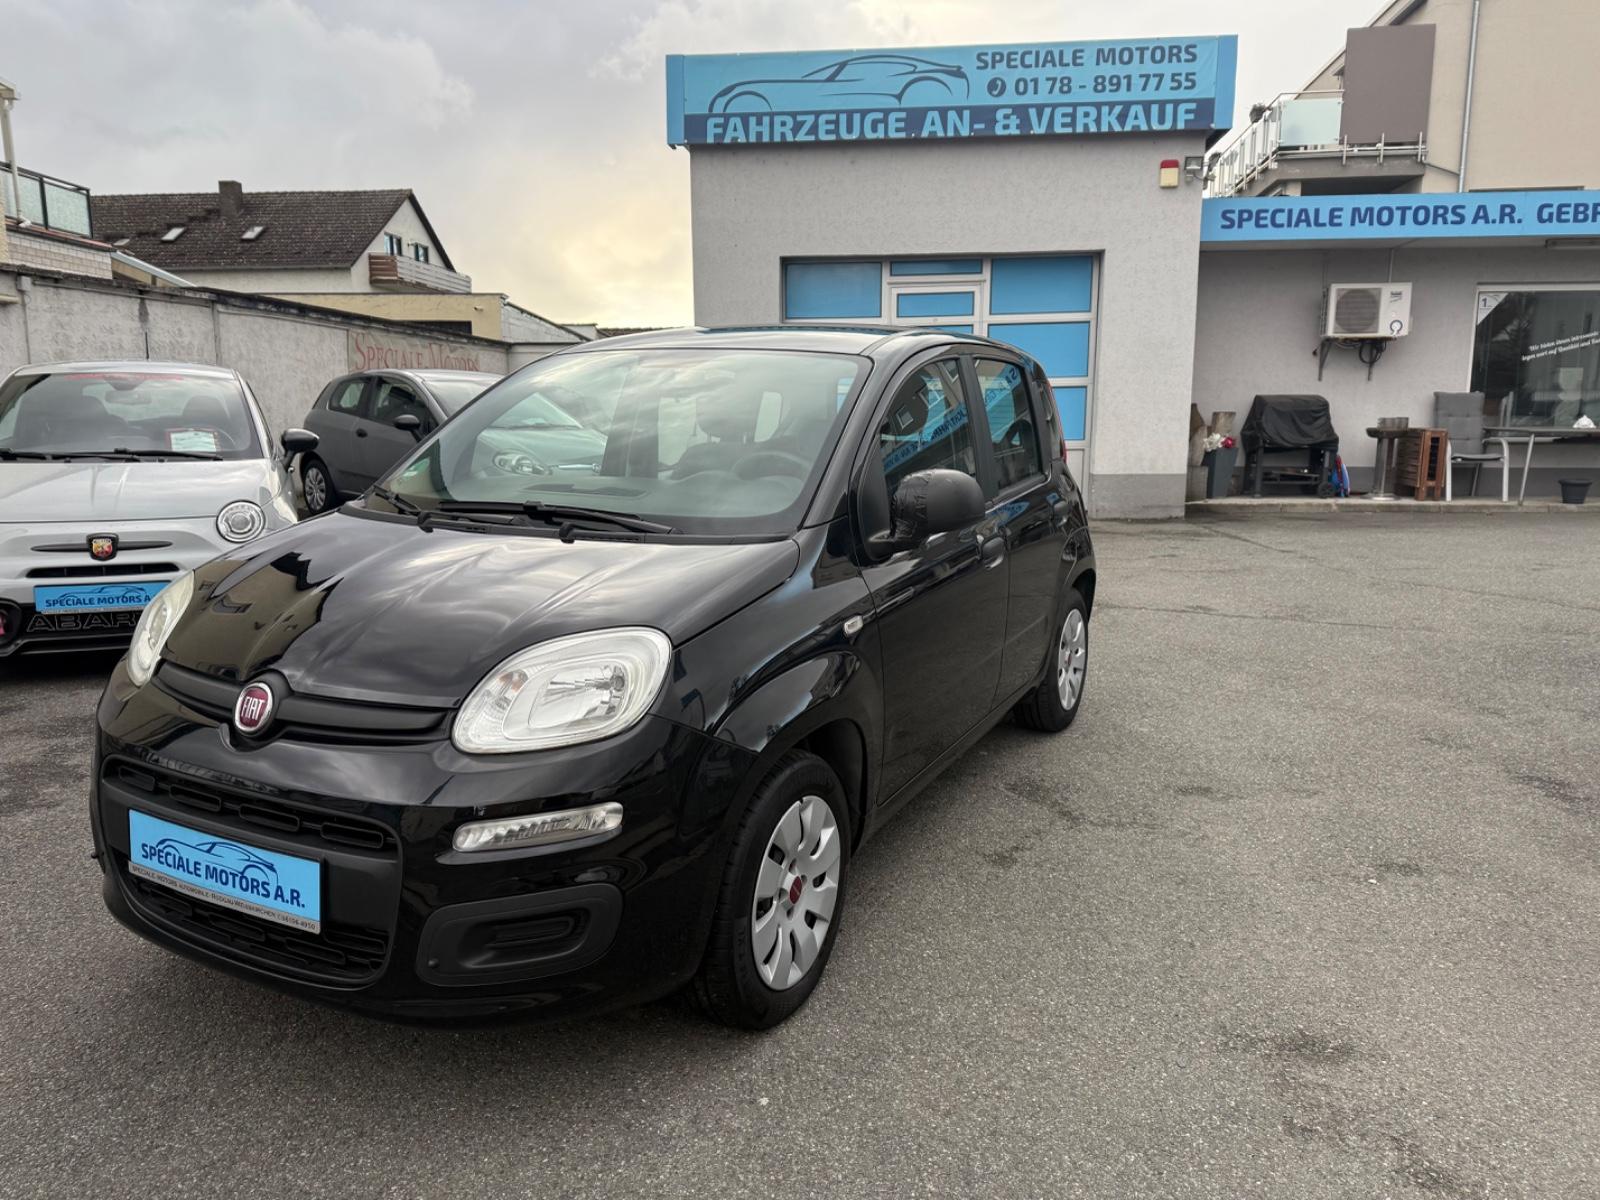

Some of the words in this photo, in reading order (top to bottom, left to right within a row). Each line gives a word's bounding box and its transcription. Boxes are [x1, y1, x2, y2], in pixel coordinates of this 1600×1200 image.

[975, 48, 1085, 70] SPECIALE
[1095, 44, 1198, 66] MOTORS
[706, 111, 908, 144] FAHRZEUGE
[920, 109, 985, 138] AN-
[994, 108, 1020, 136] &
[1028, 102, 1197, 133] VERKAUF
[1220, 206, 1343, 230] SPECIALE
[1350, 203, 1466, 227] MOTORS
[1471, 203, 1523, 225] A.R.
[354, 332, 425, 371] SPECIALE
[45, 596, 96, 608] SPECIALE
[97, 594, 142, 605] MOTORS
[27, 612, 140, 632] ABAR
[240, 696, 266, 721] FIAT
[141, 843, 202, 878] SPECIALE
[204, 864, 271, 899] MOTORS
[273, 885, 306, 909] A.R.
